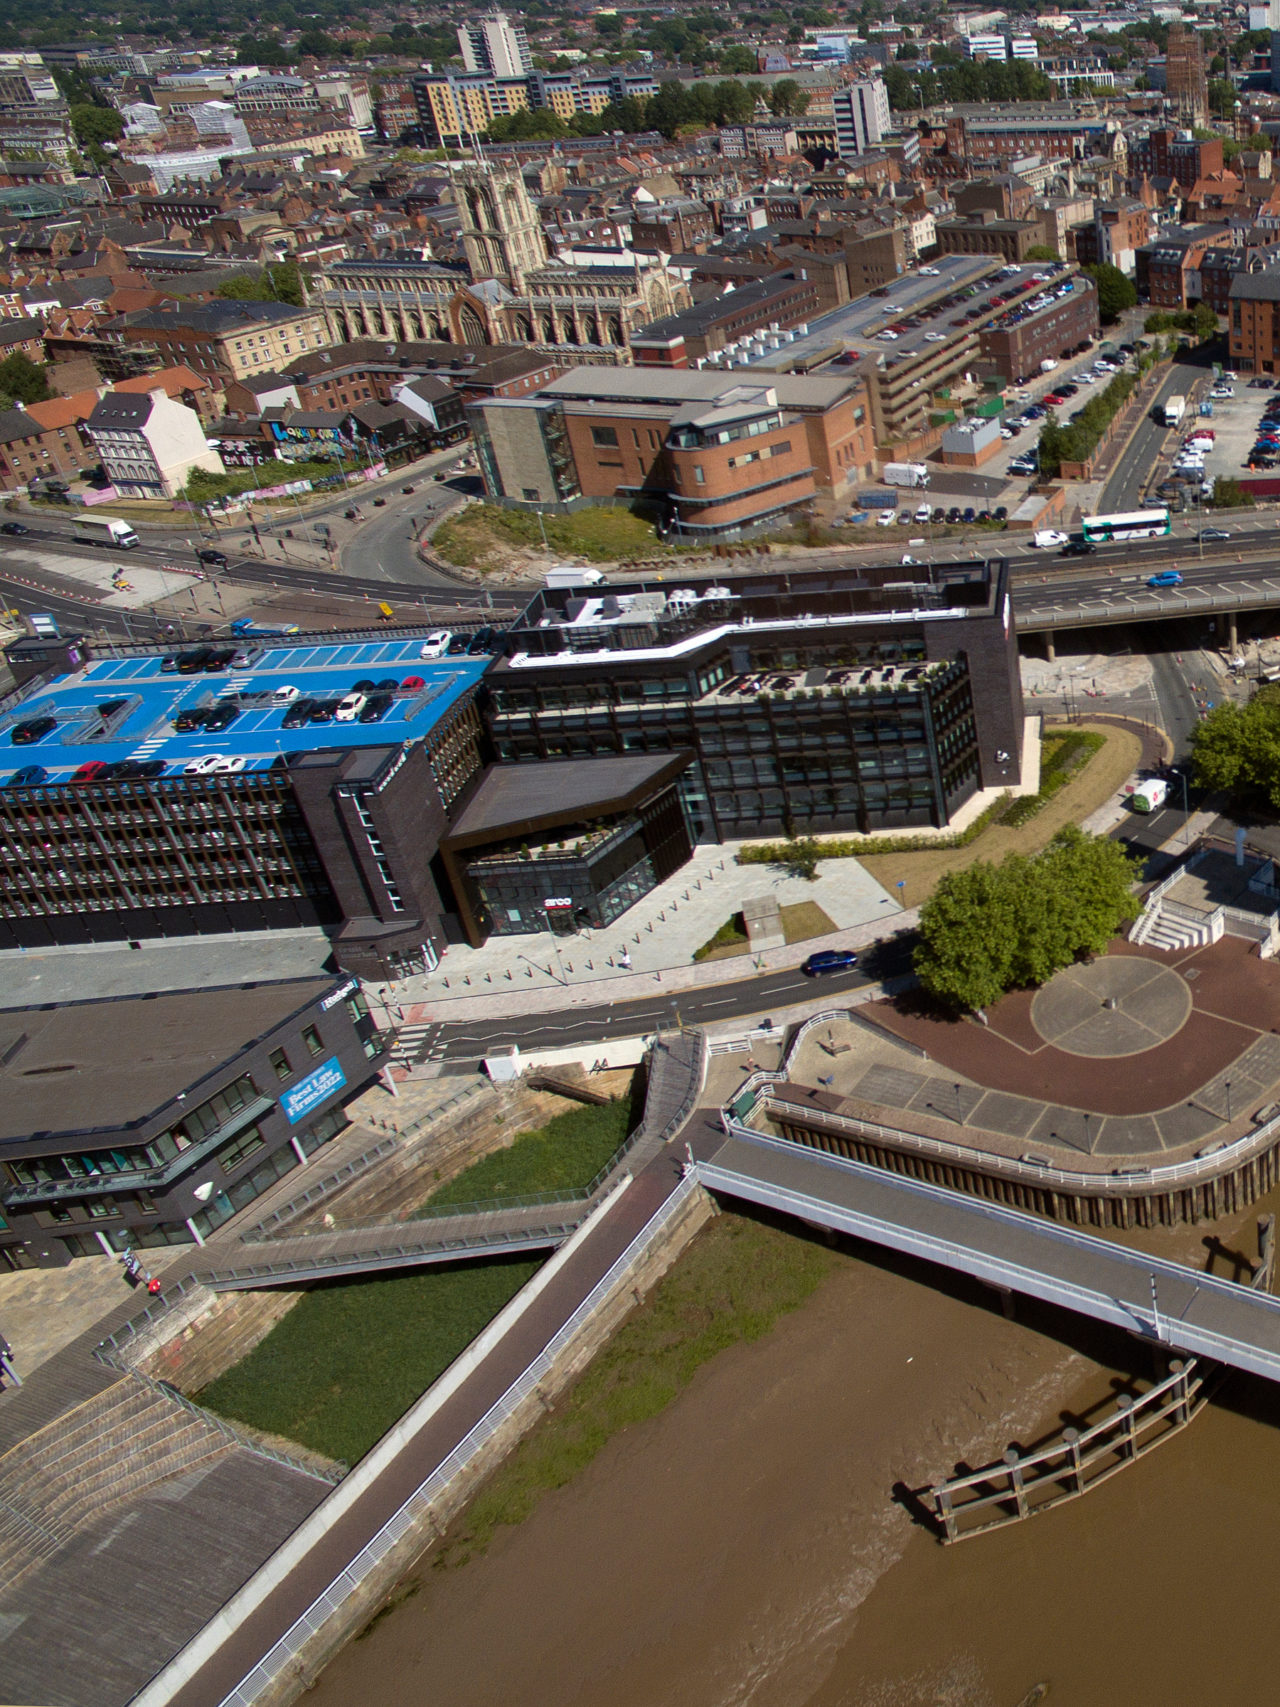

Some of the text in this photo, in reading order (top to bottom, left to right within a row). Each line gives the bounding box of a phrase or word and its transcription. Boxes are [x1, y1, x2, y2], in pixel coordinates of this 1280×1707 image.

[544, 897, 572, 907] arco
[287, 1091, 320, 1116] Firms
[316, 1072, 342, 1095] 2022
[288, 1084, 313, 1105] Best
[312, 1068, 334, 1088] Law
